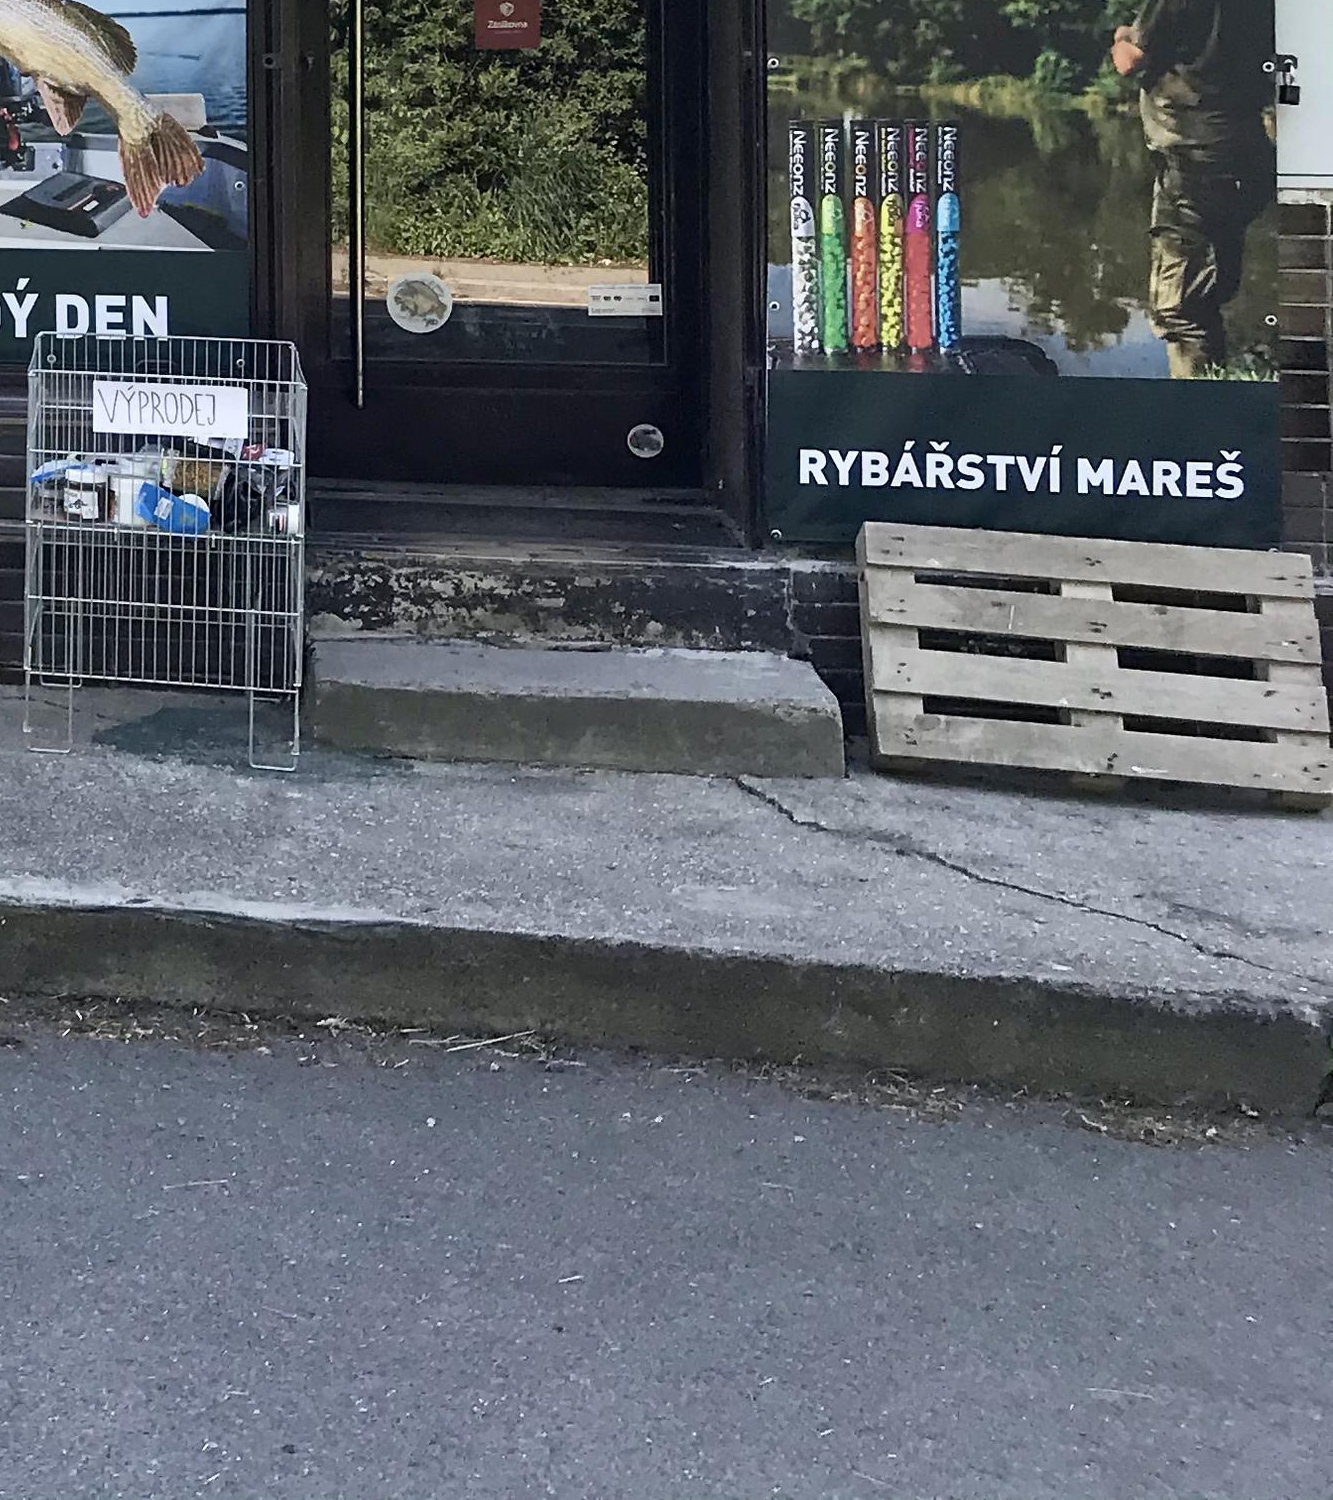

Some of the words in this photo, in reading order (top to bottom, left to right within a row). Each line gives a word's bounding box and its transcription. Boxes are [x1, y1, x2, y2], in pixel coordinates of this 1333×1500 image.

[56, 294, 169, 340] DEN
[97, 385, 217, 426] VÝPRODEJ
[799, 440, 1063, 494] RYBÁŘSTVÍ
[1077, 450, 1245, 499] MAREŠ
